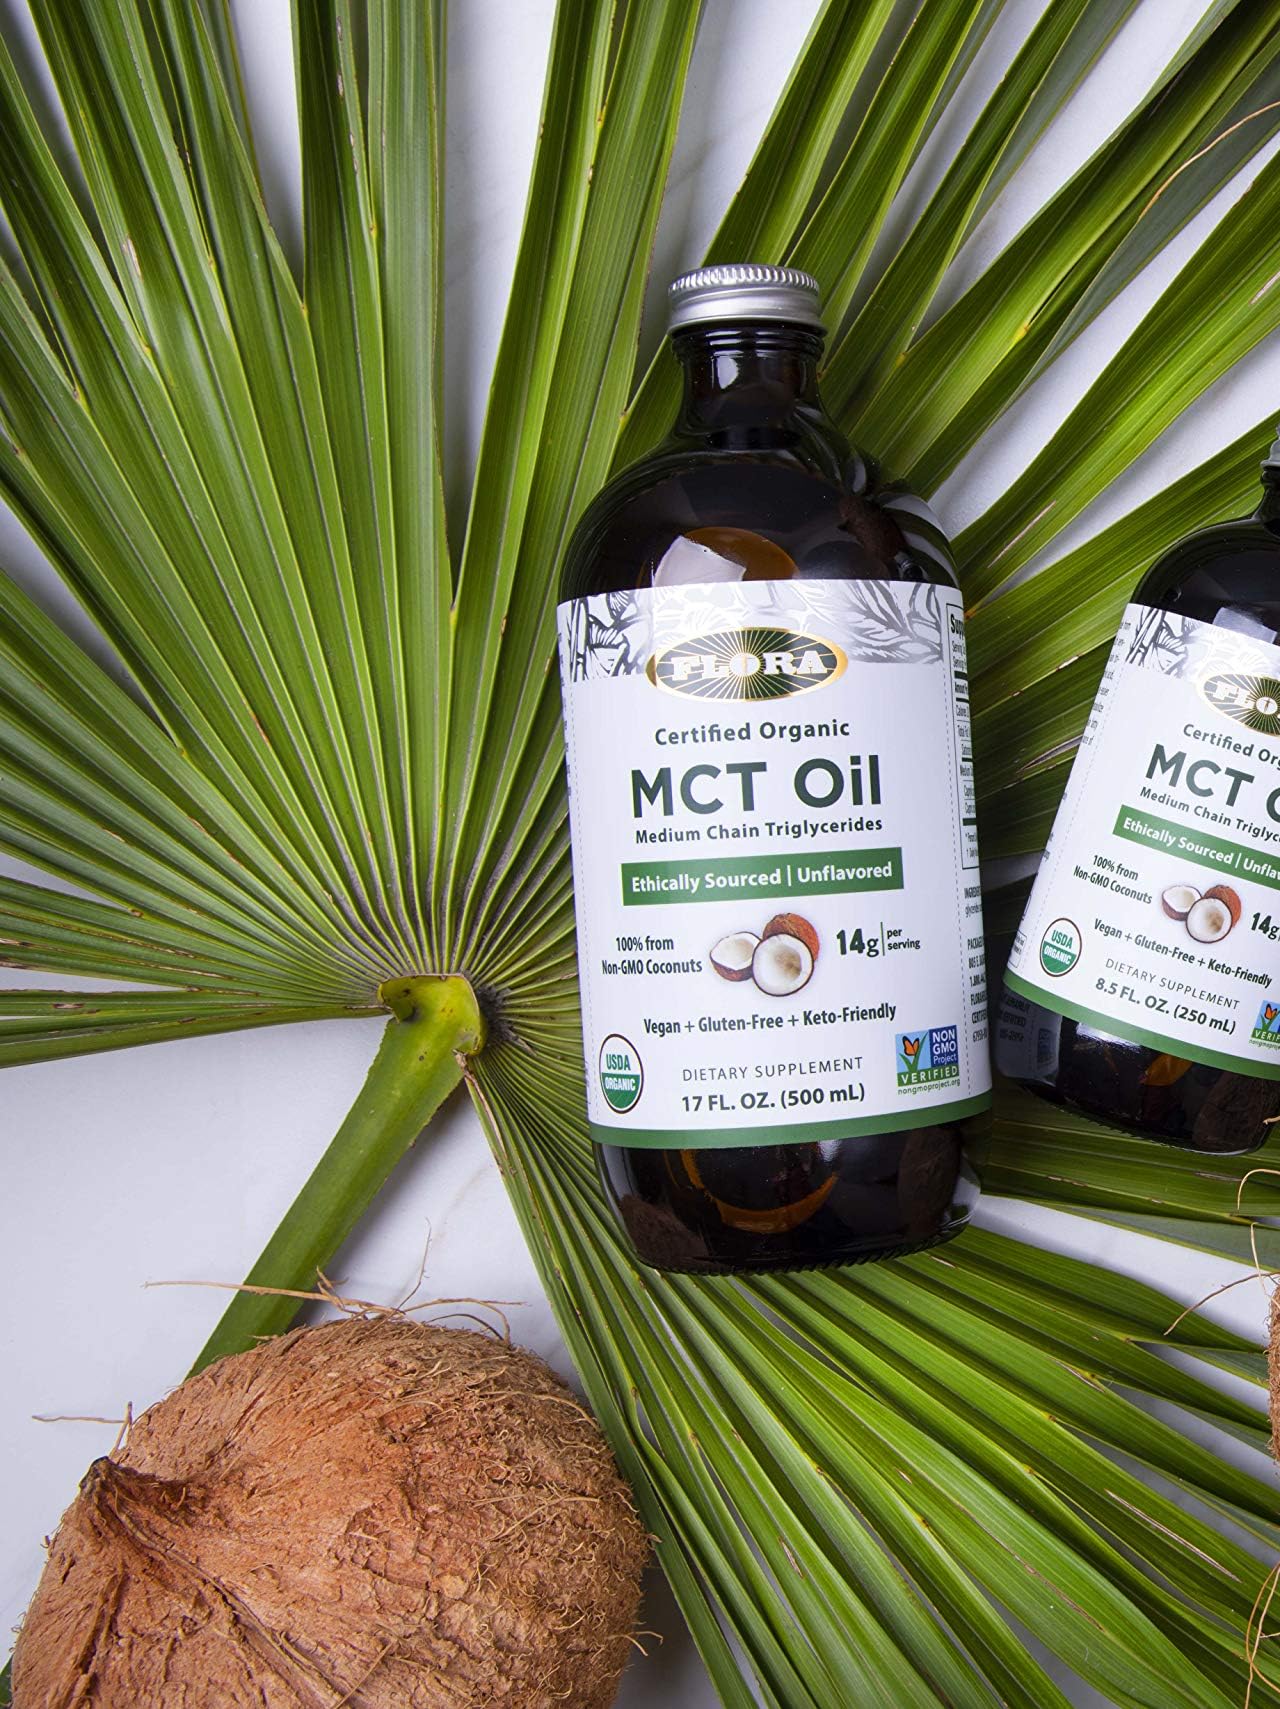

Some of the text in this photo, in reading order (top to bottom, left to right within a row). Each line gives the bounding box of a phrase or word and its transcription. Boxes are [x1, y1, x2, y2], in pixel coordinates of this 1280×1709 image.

[671, 650, 828, 680] FLORA
[655, 719, 850, 745] Certified Organic
[1183, 723, 1254, 758] Certified
[631, 755, 882, 818] MCT Oil
[1145, 744, 1255, 807] MCT
[1140, 786, 1189, 814] Medium
[1194, 804, 1231, 826] Chain
[635, 816, 882, 844] Medium Chain Triglycerides
[1123, 817, 1176, 846] Ethically
[1178, 836, 1233, 865] Sourced
[632, 874, 700, 893] Ethically
[705, 868, 781, 889] Sourced
[797, 862, 892, 884] Unflavored
[1092, 854, 1139, 882] 100% from
[1073, 865, 1152, 904] Non-GMO Coconuts
[887, 928, 902, 940] per
[1052, 929, 1074, 949] USDA
[1251, 911, 1280, 940] 14g
[616, 935, 674, 952] 100% from
[836, 929, 880, 957] 14g
[887, 938, 921, 952] serving
[1044, 945, 1071, 965] ORGANIC
[1094, 918, 1272, 988] Vegan + Gluten-Free + Keto-Friendly
[602, 958, 702, 975] Non-GMO Coconuts
[1105, 958, 1240, 1011] DIETARY SUPPLEMENT
[644, 1003, 897, 1037] Vegan + Gluten-Free + Keto-Friendly
[1095, 977, 1237, 1036] 8.5 FL. OZ. (250 mL)
[932, 1029, 955, 1043] NON
[933, 1041, 956, 1054] GMO
[606, 1053, 631, 1071] USDA
[682, 1057, 863, 1082] DIETARY SUPPLEMENT
[934, 1053, 956, 1065] Project
[604, 1076, 636, 1092] ORGANIC
[898, 1079, 960, 1095] nongmoproject.org
[901, 1066, 957, 1084] VERIFIED
[682, 1083, 865, 1112] 17 FL. OZ. (500 mL)
